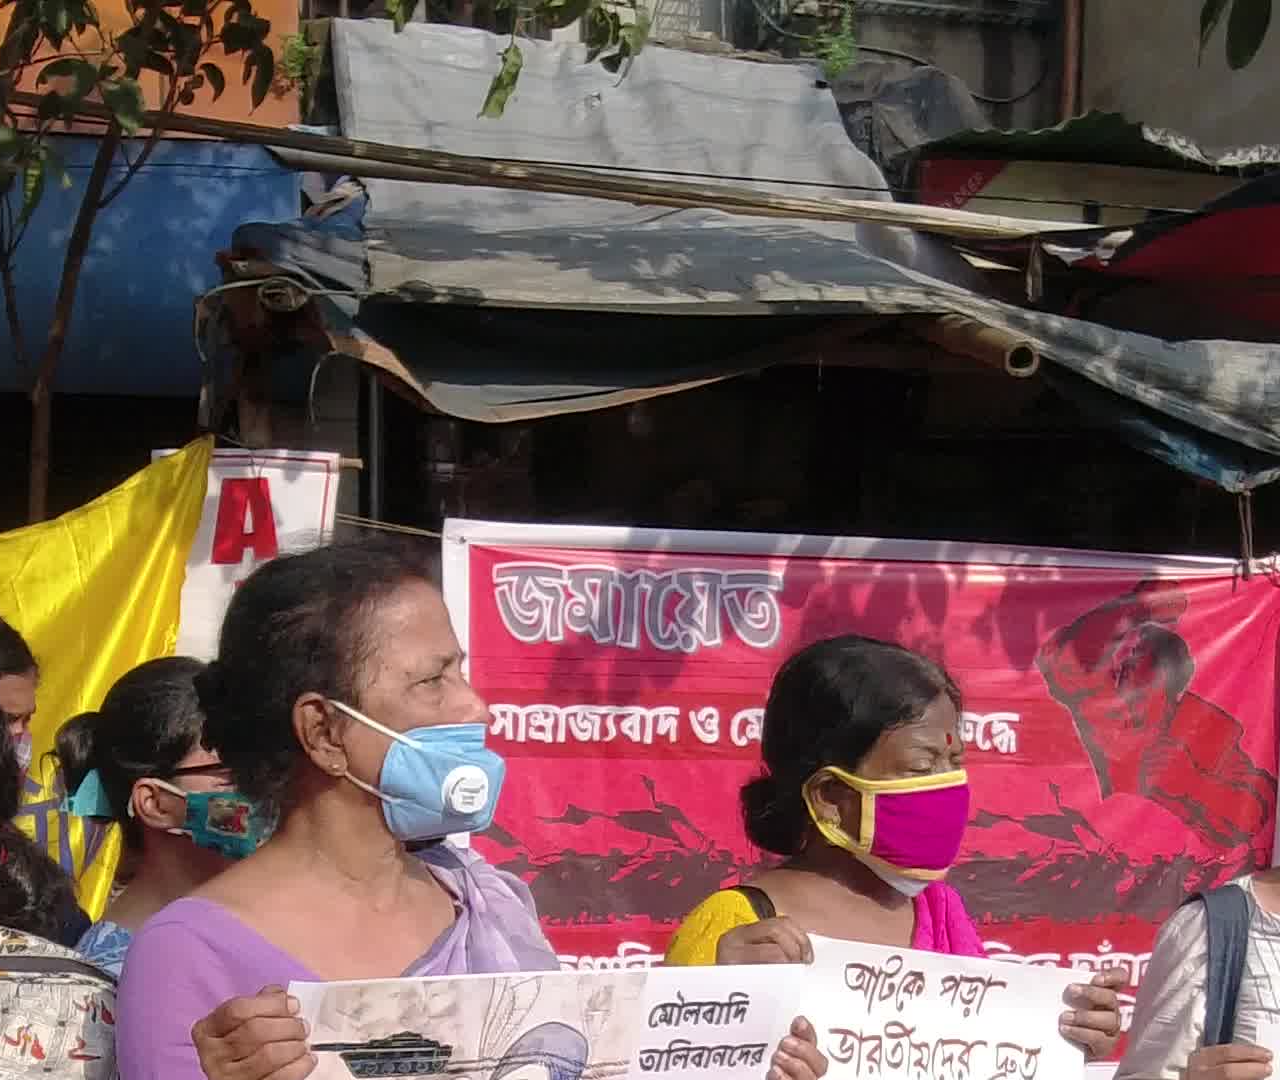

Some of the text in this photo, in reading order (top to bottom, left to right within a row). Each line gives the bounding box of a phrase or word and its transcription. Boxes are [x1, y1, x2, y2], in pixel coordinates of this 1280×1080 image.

[492, 561, 782, 653] জমায়েত
[488, 704, 680, 745] সাম্রাজ্যবাদ
[689, 706, 720, 745] ও
[844, 954, 925, 1015] আটকে
[648, 990, 749, 1028] মৌলবাদি
[638, 1039, 768, 1073] তালিবানদের
